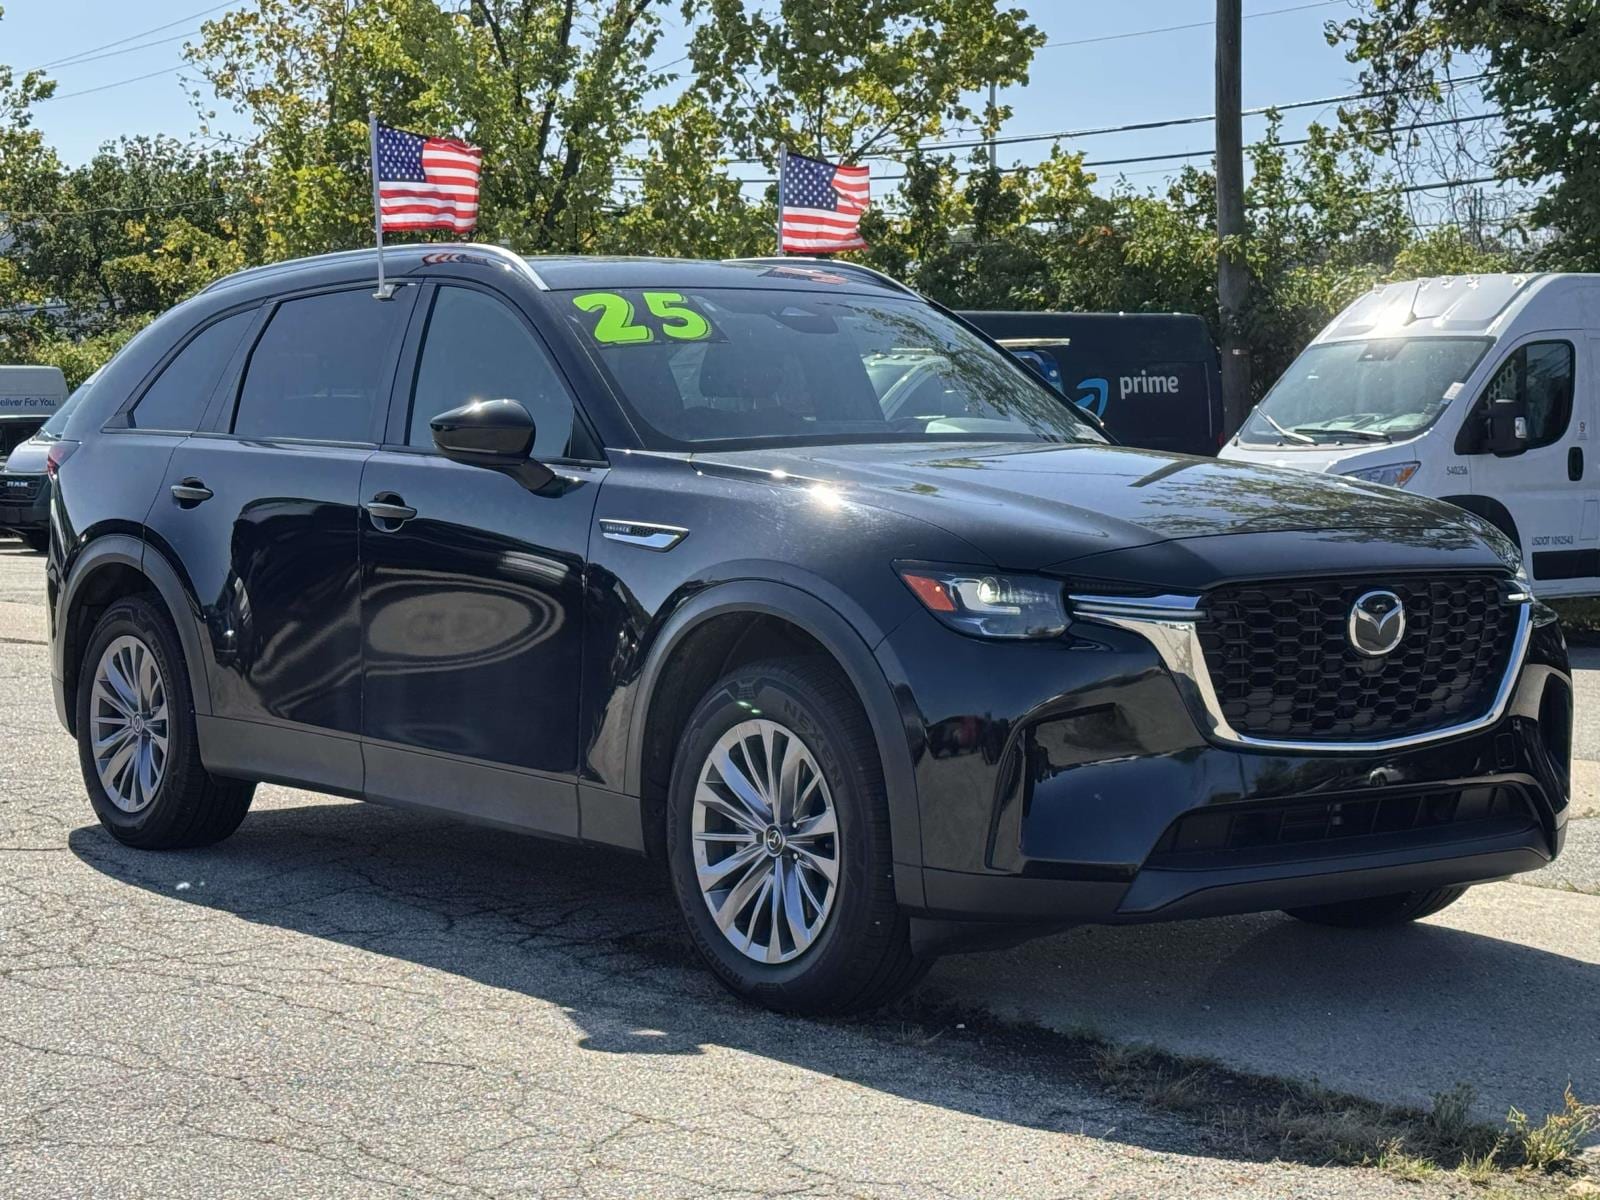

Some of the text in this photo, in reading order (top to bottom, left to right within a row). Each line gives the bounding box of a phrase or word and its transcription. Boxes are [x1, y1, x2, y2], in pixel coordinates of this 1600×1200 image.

[572, 292, 712, 344] 25
[1119, 369, 1179, 400] prime
[24, 397, 38, 407] For
[6, 480, 28, 488] RAM
[1532, 535, 1550, 547] USDOT
[783, 698, 843, 789] NEXEN
